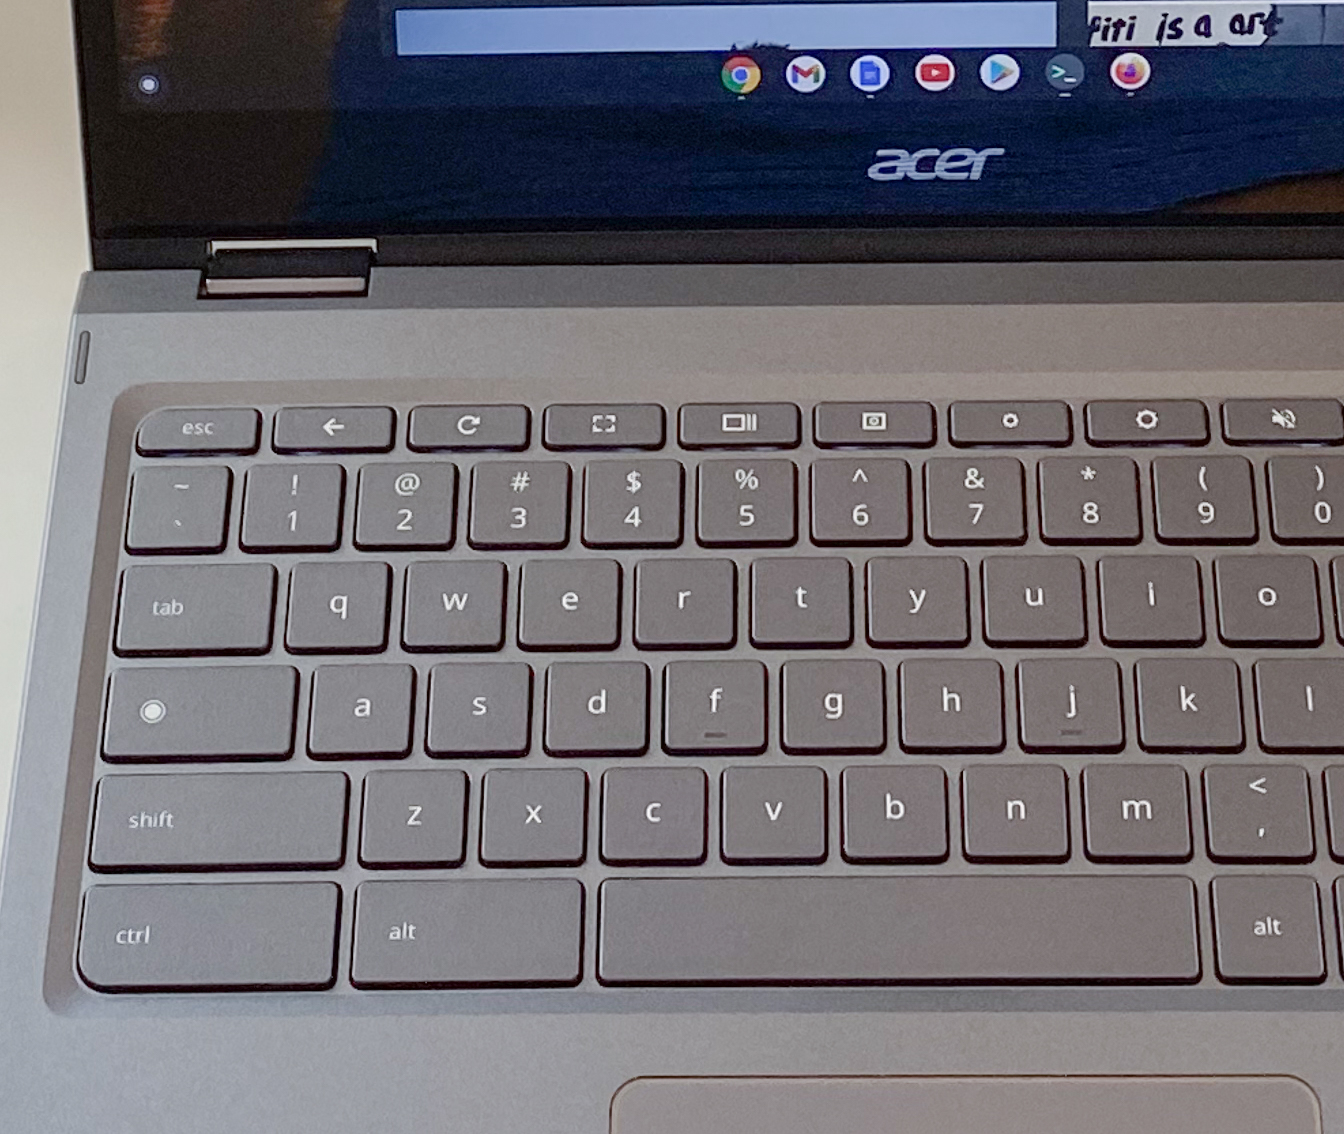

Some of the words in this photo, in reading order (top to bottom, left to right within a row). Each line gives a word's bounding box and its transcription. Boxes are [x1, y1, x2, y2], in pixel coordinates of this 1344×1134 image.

[1156, 13, 1184, 42] is
[1194, 15, 1212, 38] a
[868, 148, 1005, 180] acer
[182, 423, 213, 435] esc
[153, 599, 183, 615] tab
[130, 811, 173, 828] shift
[390, 922, 415, 939] alt
[1254, 917, 1281, 935] alt
[117, 926, 149, 944] ctrl
